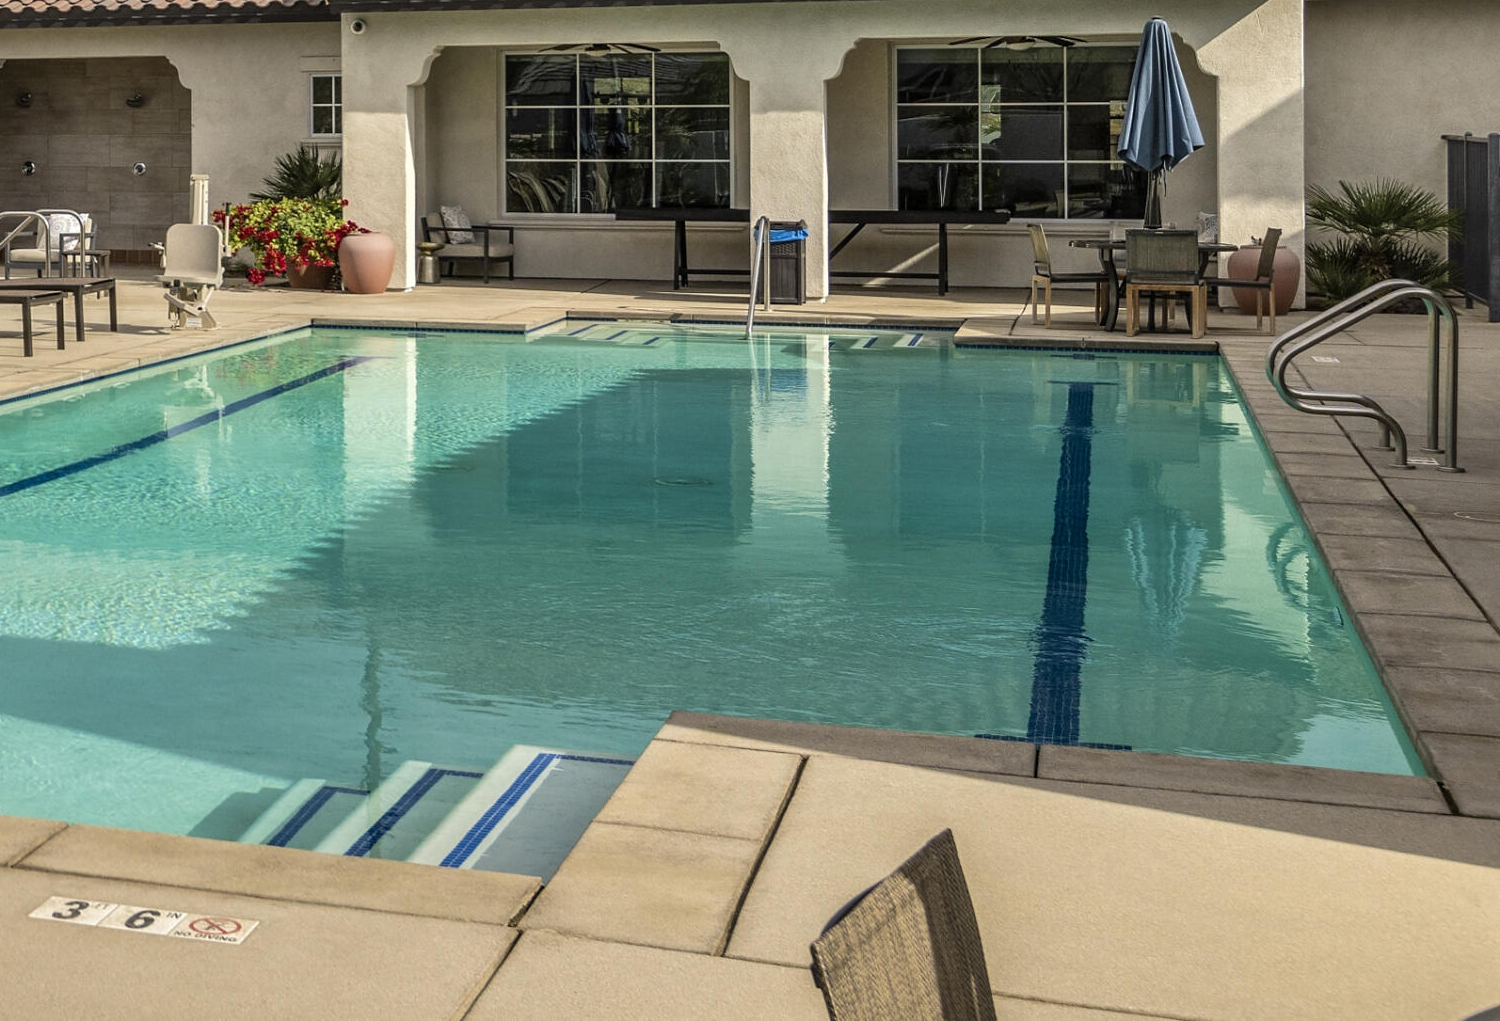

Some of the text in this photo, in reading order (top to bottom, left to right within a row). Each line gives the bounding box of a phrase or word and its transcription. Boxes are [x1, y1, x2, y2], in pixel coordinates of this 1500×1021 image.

[52, 901, 89, 919] 3
[124, 910, 161, 929] 6
[165, 911, 183, 920] IN
[194, 933, 238, 943] DIVING
